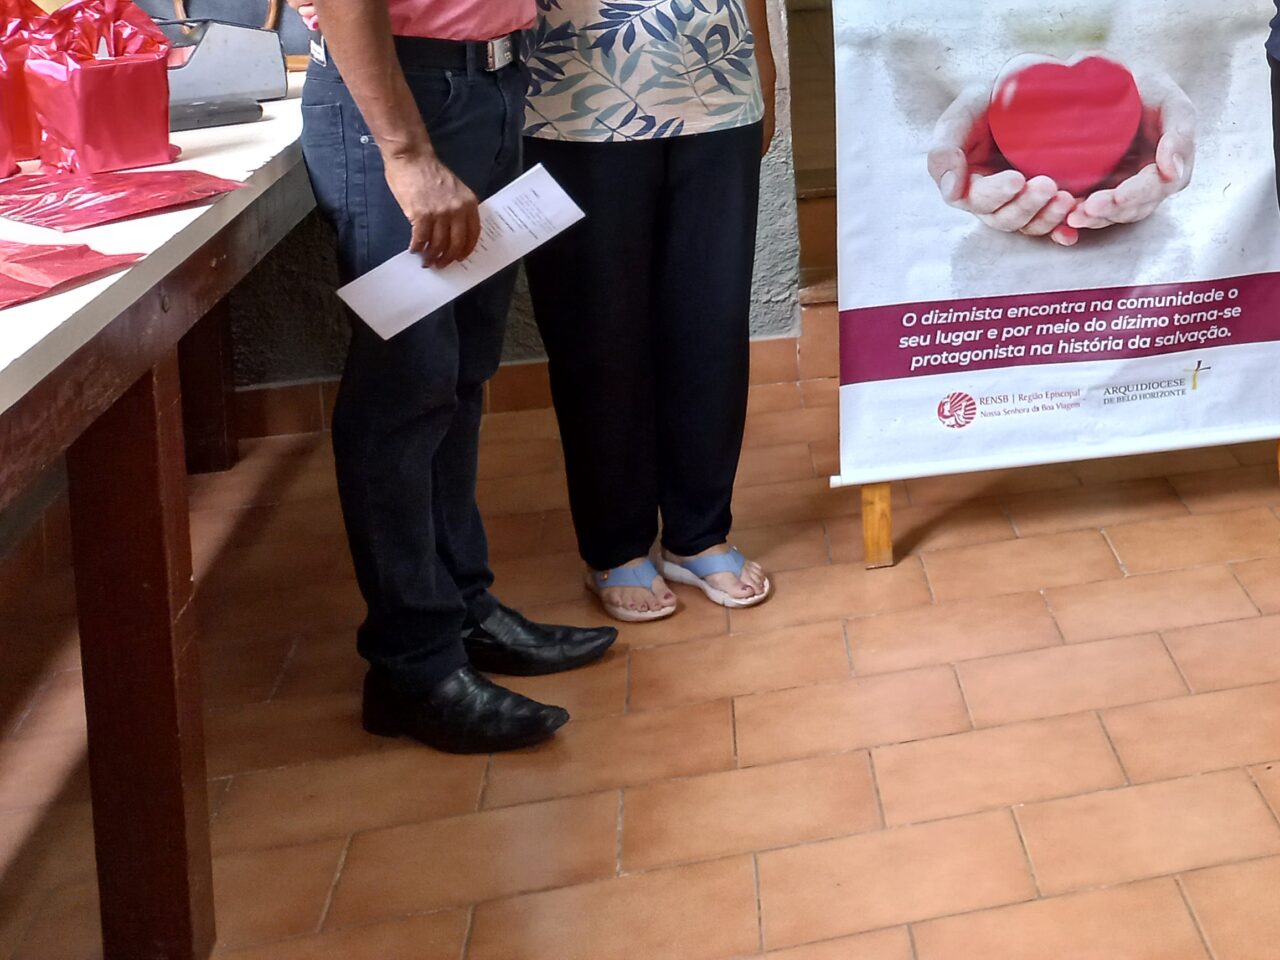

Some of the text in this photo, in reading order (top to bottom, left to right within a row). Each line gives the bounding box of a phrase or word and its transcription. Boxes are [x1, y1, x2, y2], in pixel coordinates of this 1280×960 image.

[902, 288, 1239, 327] O dizimista encontra na comunidade o
[898, 306, 1242, 349] seu lugar e por meio do dízimo torna-se
[910, 325, 1232, 372] protagonista na história da salvação.
[979, 394, 1010, 406] RENSB
[1103, 377, 1187, 397] ARQUIDIOCESE
[1103, 389, 1187, 406] DE BELO HORIZONTE
